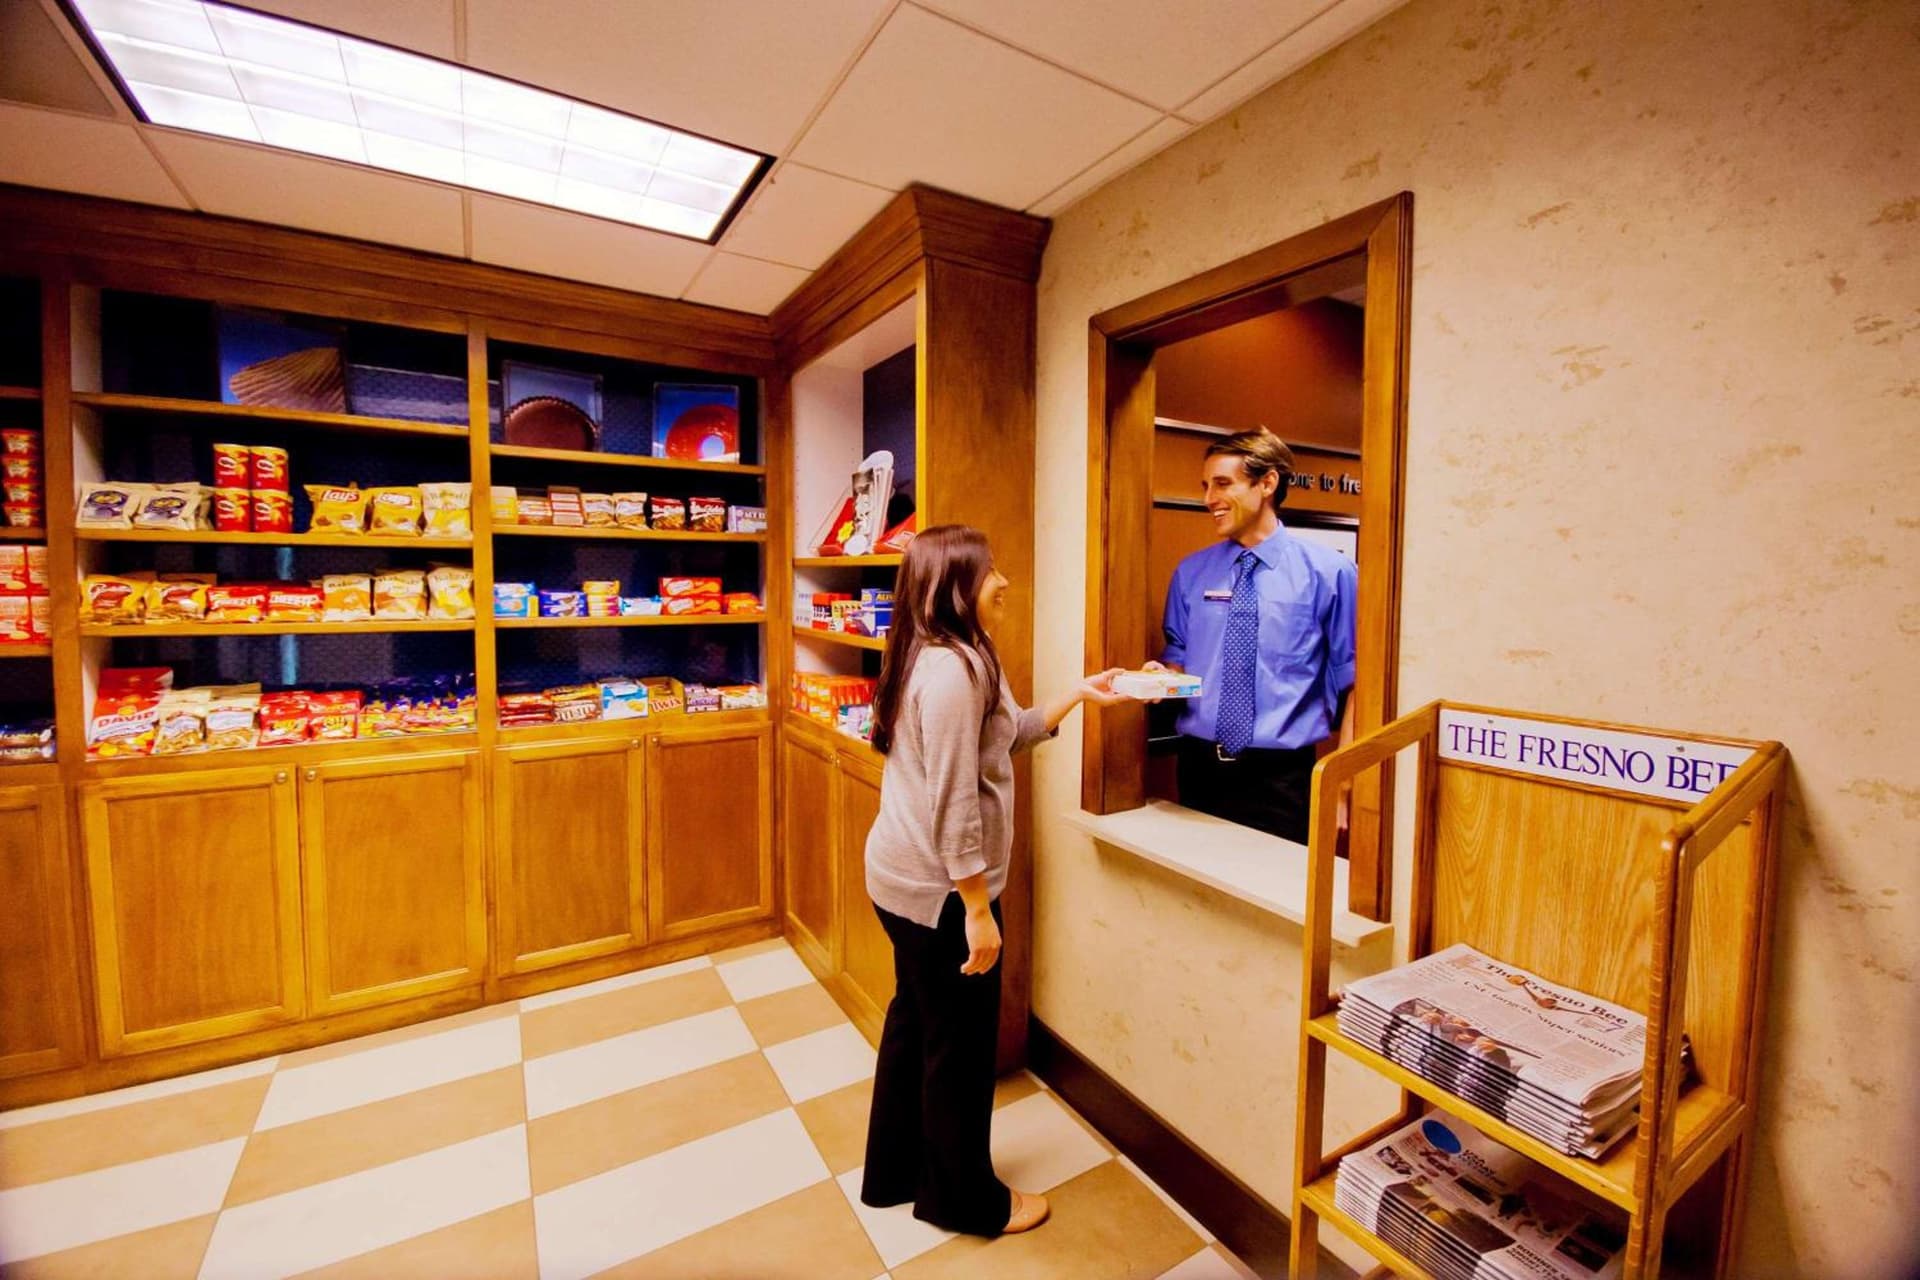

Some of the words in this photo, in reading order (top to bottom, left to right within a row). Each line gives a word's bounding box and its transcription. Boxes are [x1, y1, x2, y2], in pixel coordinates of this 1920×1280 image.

[1322, 473, 1336, 490] to
[99, 711, 154, 728] DAVID
[1448, 723, 1507, 760] THE
[1517, 734, 1655, 784] FRESNO
[1590, 1005, 1628, 1025] Bee
